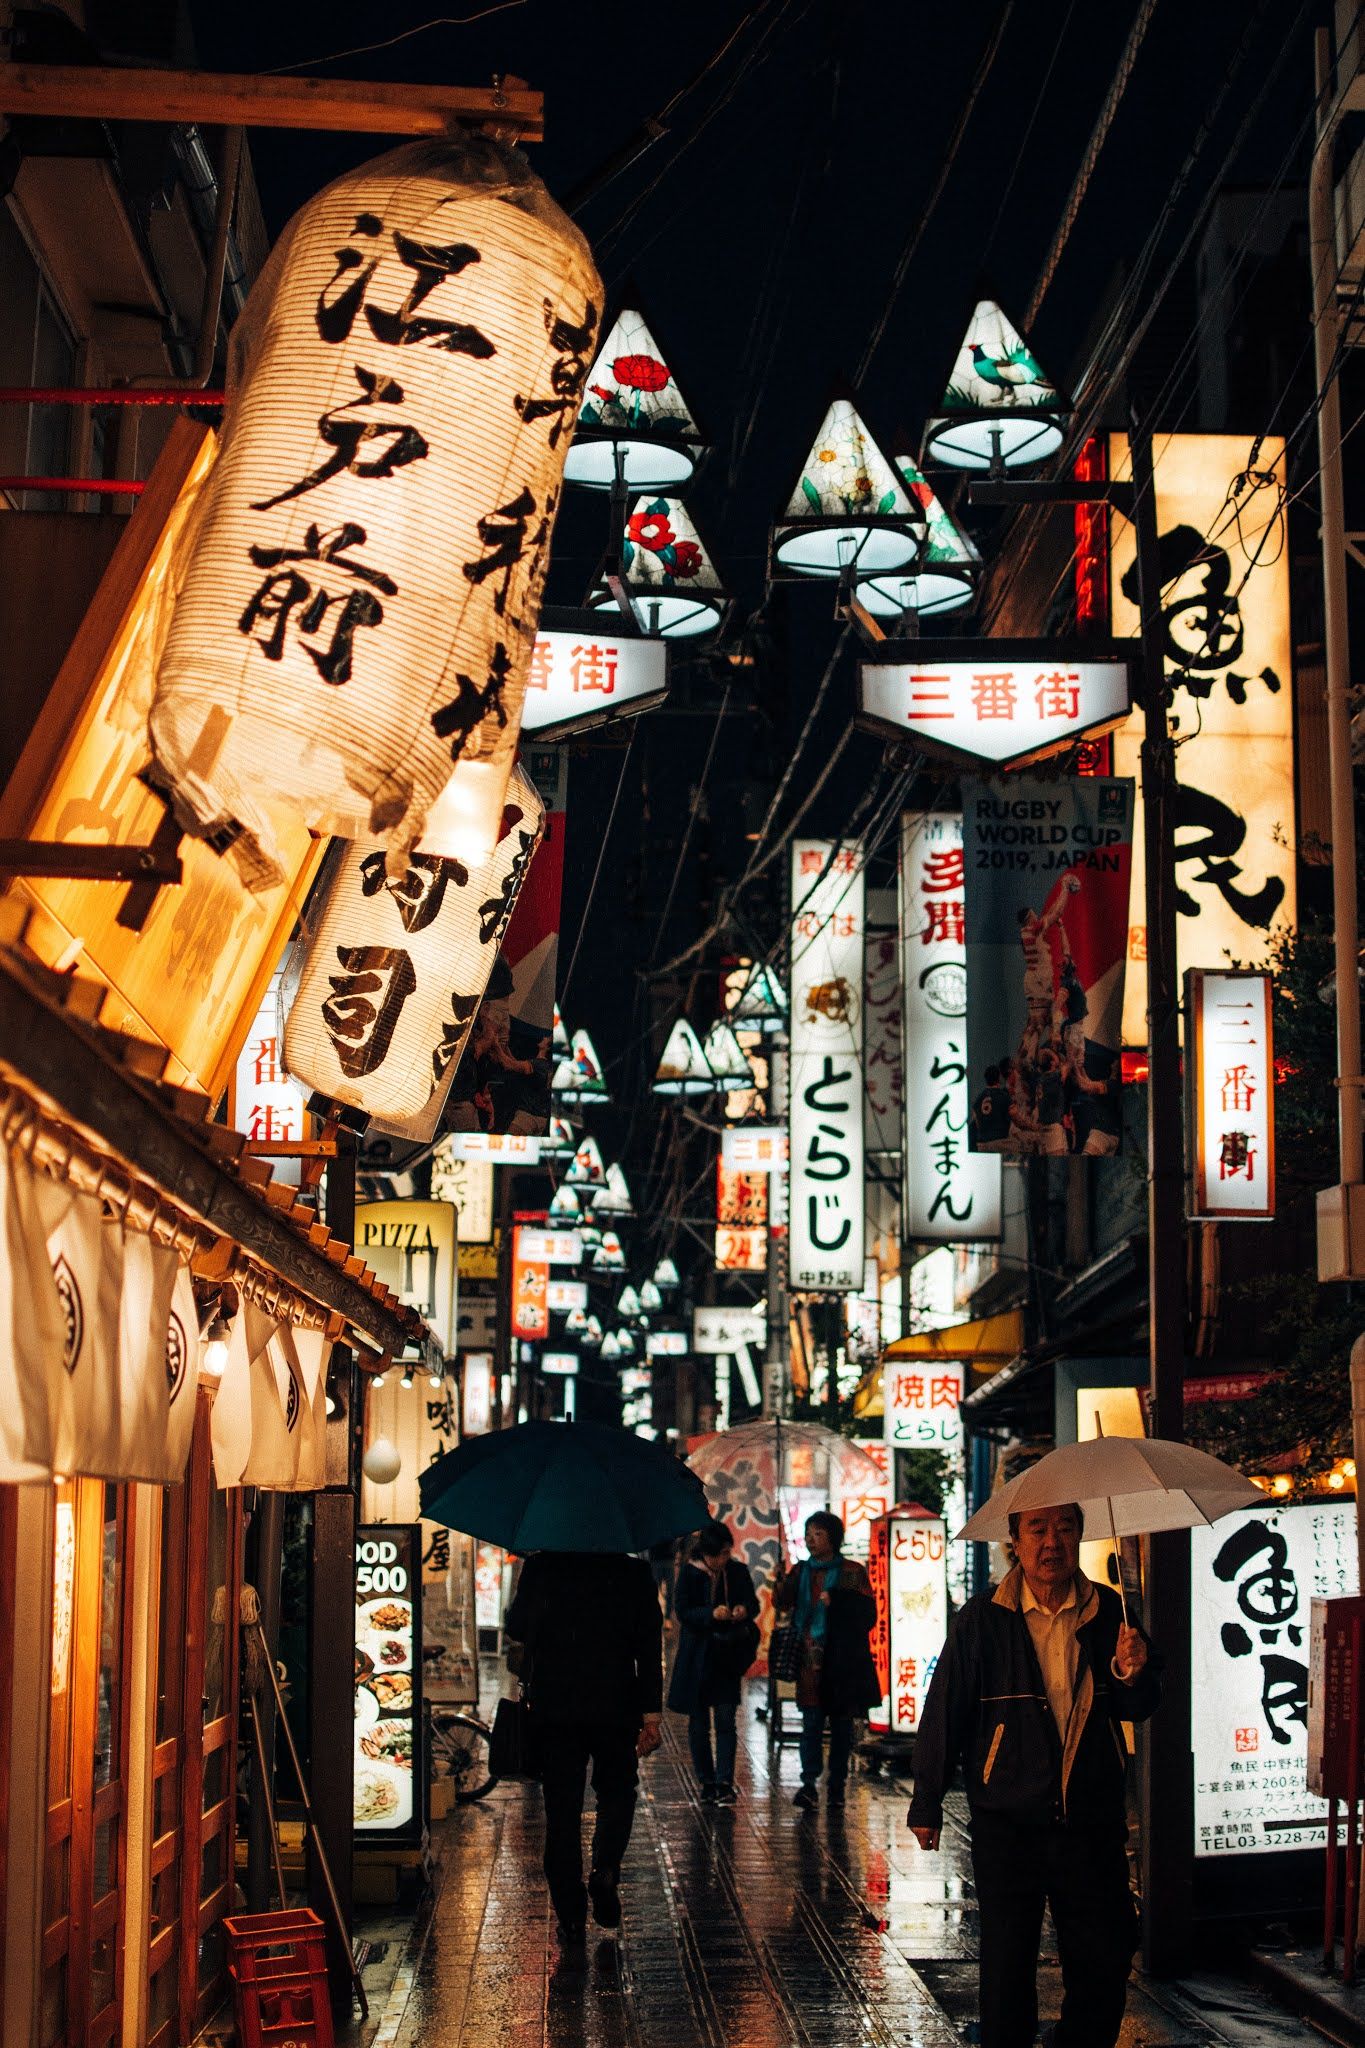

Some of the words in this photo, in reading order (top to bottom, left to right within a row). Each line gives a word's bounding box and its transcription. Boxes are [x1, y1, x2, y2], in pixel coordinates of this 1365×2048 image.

[236, 211, 497, 687] 江戸前
[907, 671, 1081, 721] 三番街
[975, 800, 1061, 820] RUGBY
[975, 825, 1067, 846] WORLD
[1070, 825, 1122, 848] CUP
[974, 849, 1036, 873] 2019,
[1041, 849, 1121, 873] JAPAN
[925, 1042, 973, 1222] らんまん
[802, 1055, 853, 1252] とらじ
[363, 1222, 434, 1252] PIZZA
[800, 1269, 853, 1287] 中野店
[892, 1373, 960, 1410] 焼肉
[893, 1418, 959, 1442] とらじ
[893, 1528, 943, 1561] とらじ
[355, 1566, 408, 1593] 500
[897, 1656, 917, 1725] 焼肉
